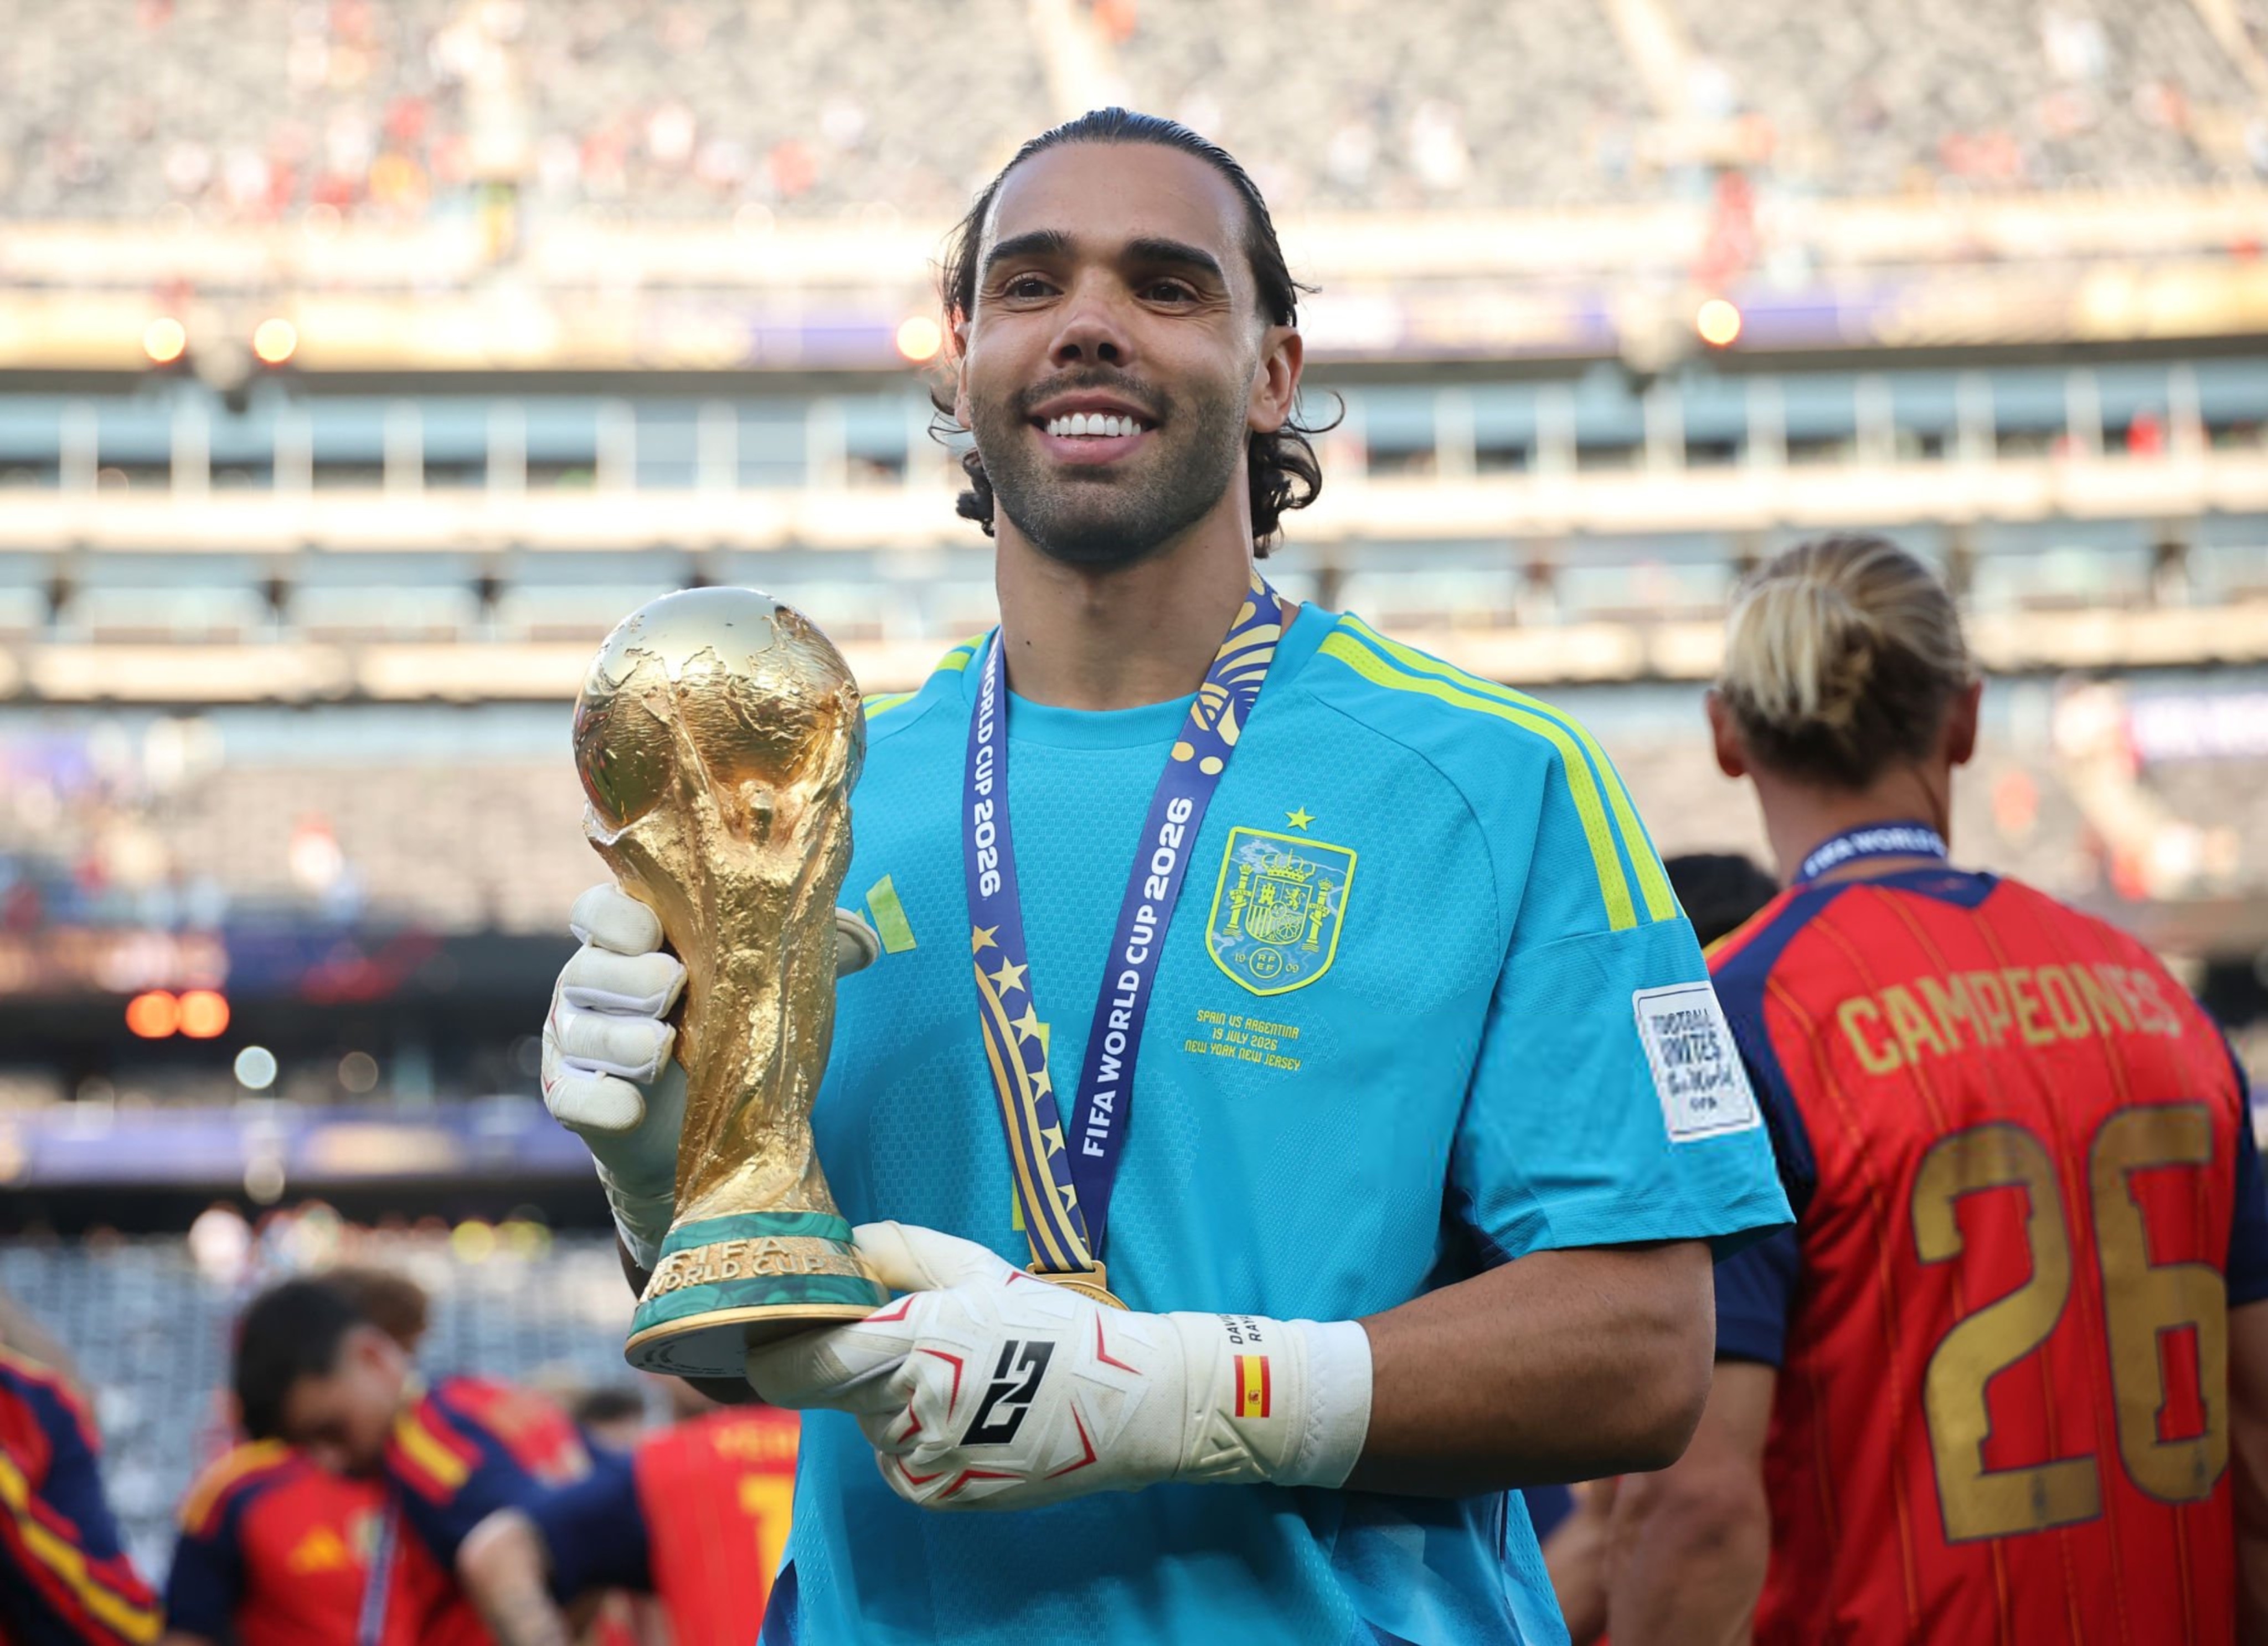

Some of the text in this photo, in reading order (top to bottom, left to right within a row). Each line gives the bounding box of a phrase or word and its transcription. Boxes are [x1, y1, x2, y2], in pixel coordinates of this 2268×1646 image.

[975, 745, 993, 796] CUP
[975, 799, 1001, 897] 2026
[1082, 798, 1193, 1158] FIFA WORLD CUP 2026
[1234, 953, 1246, 963] 19
[1197, 1009, 1226, 1026] SPAIN
[1245, 1017, 1300, 1040] ARGENTINA
[1212, 1027, 1278, 1051] 19 JULY 2026
[1837, 963, 2182, 1076] CAMPEONES
[1184, 1039, 1301, 1072] NEW YORK NEW JERSEY
[640, 1254, 827, 1302] WORLD CUP
[664, 1237, 791, 1271] FIFA
[1910, 1100, 2230, 1546] 26
